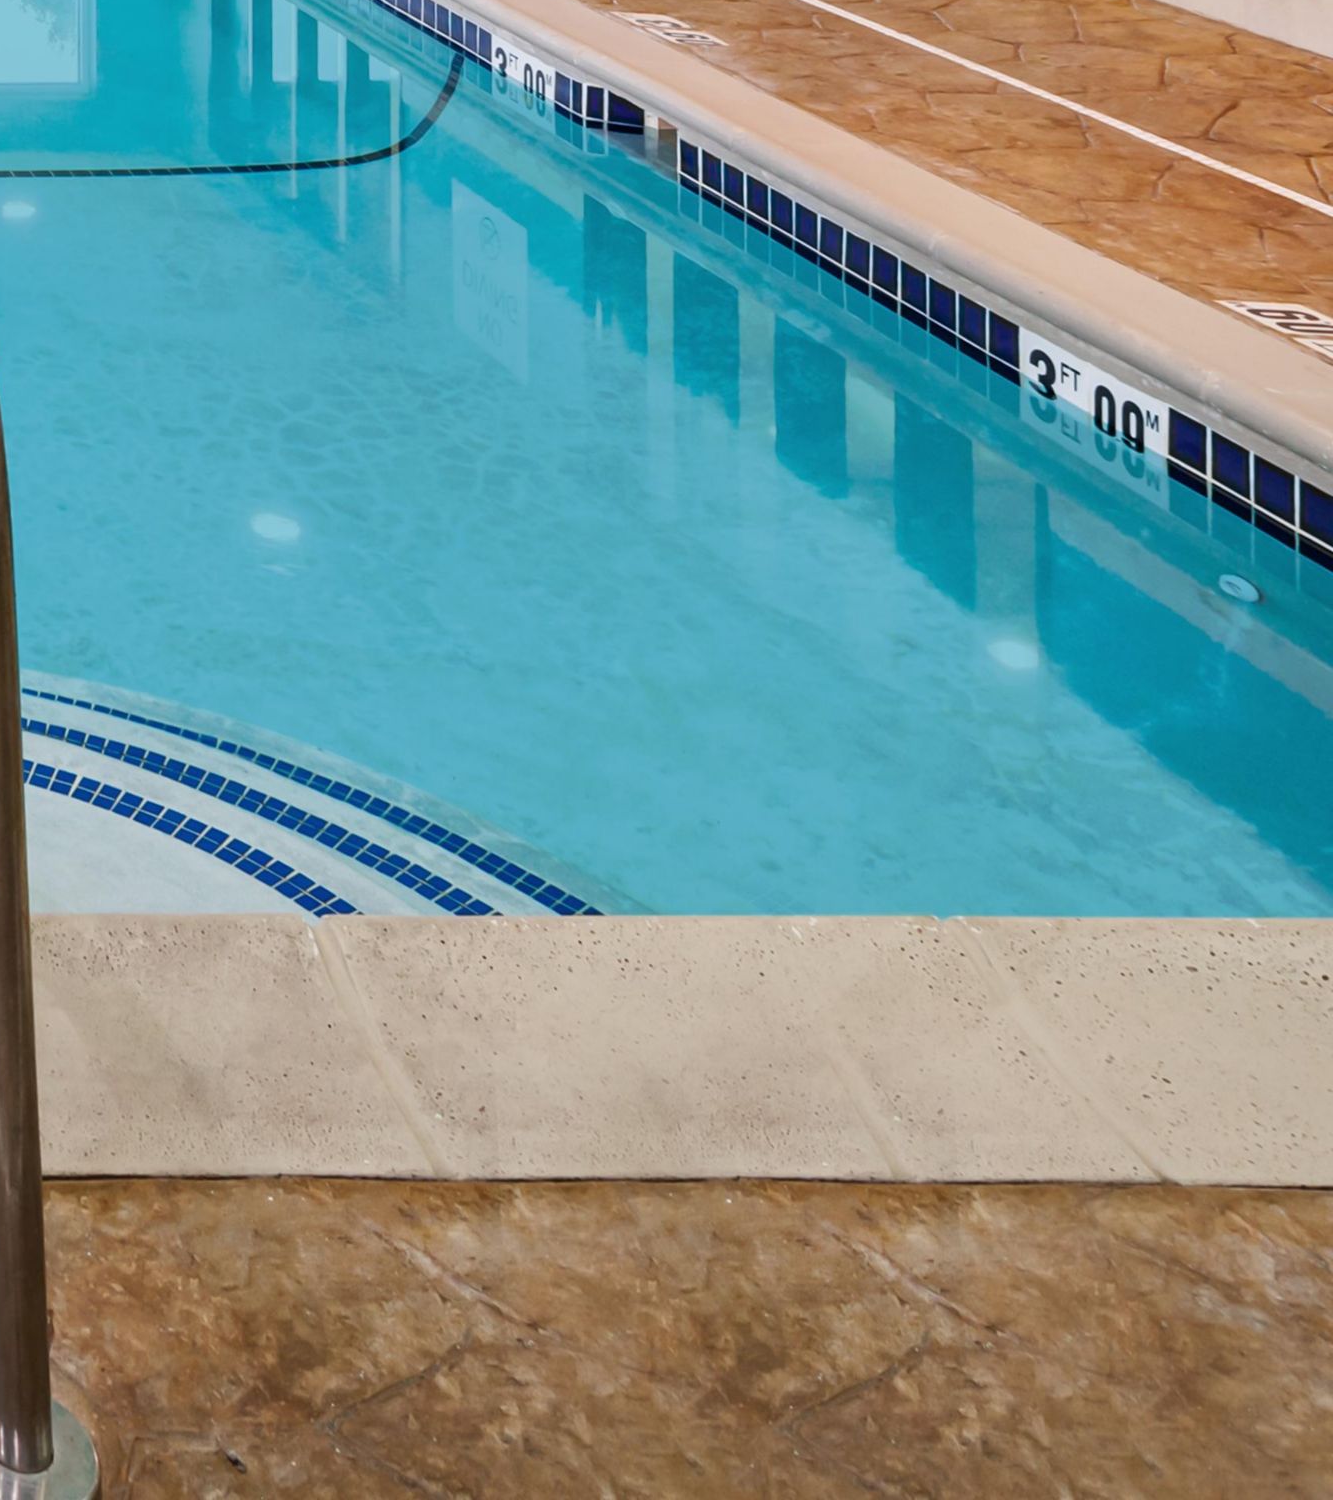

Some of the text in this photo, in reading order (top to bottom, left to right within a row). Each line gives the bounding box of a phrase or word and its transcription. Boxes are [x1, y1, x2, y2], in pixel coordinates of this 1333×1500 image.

[495, 47, 507, 78] 3
[1028, 349, 1057, 401] 3
[1061, 362, 1081, 391] FT
[1145, 410, 1160, 433] M
